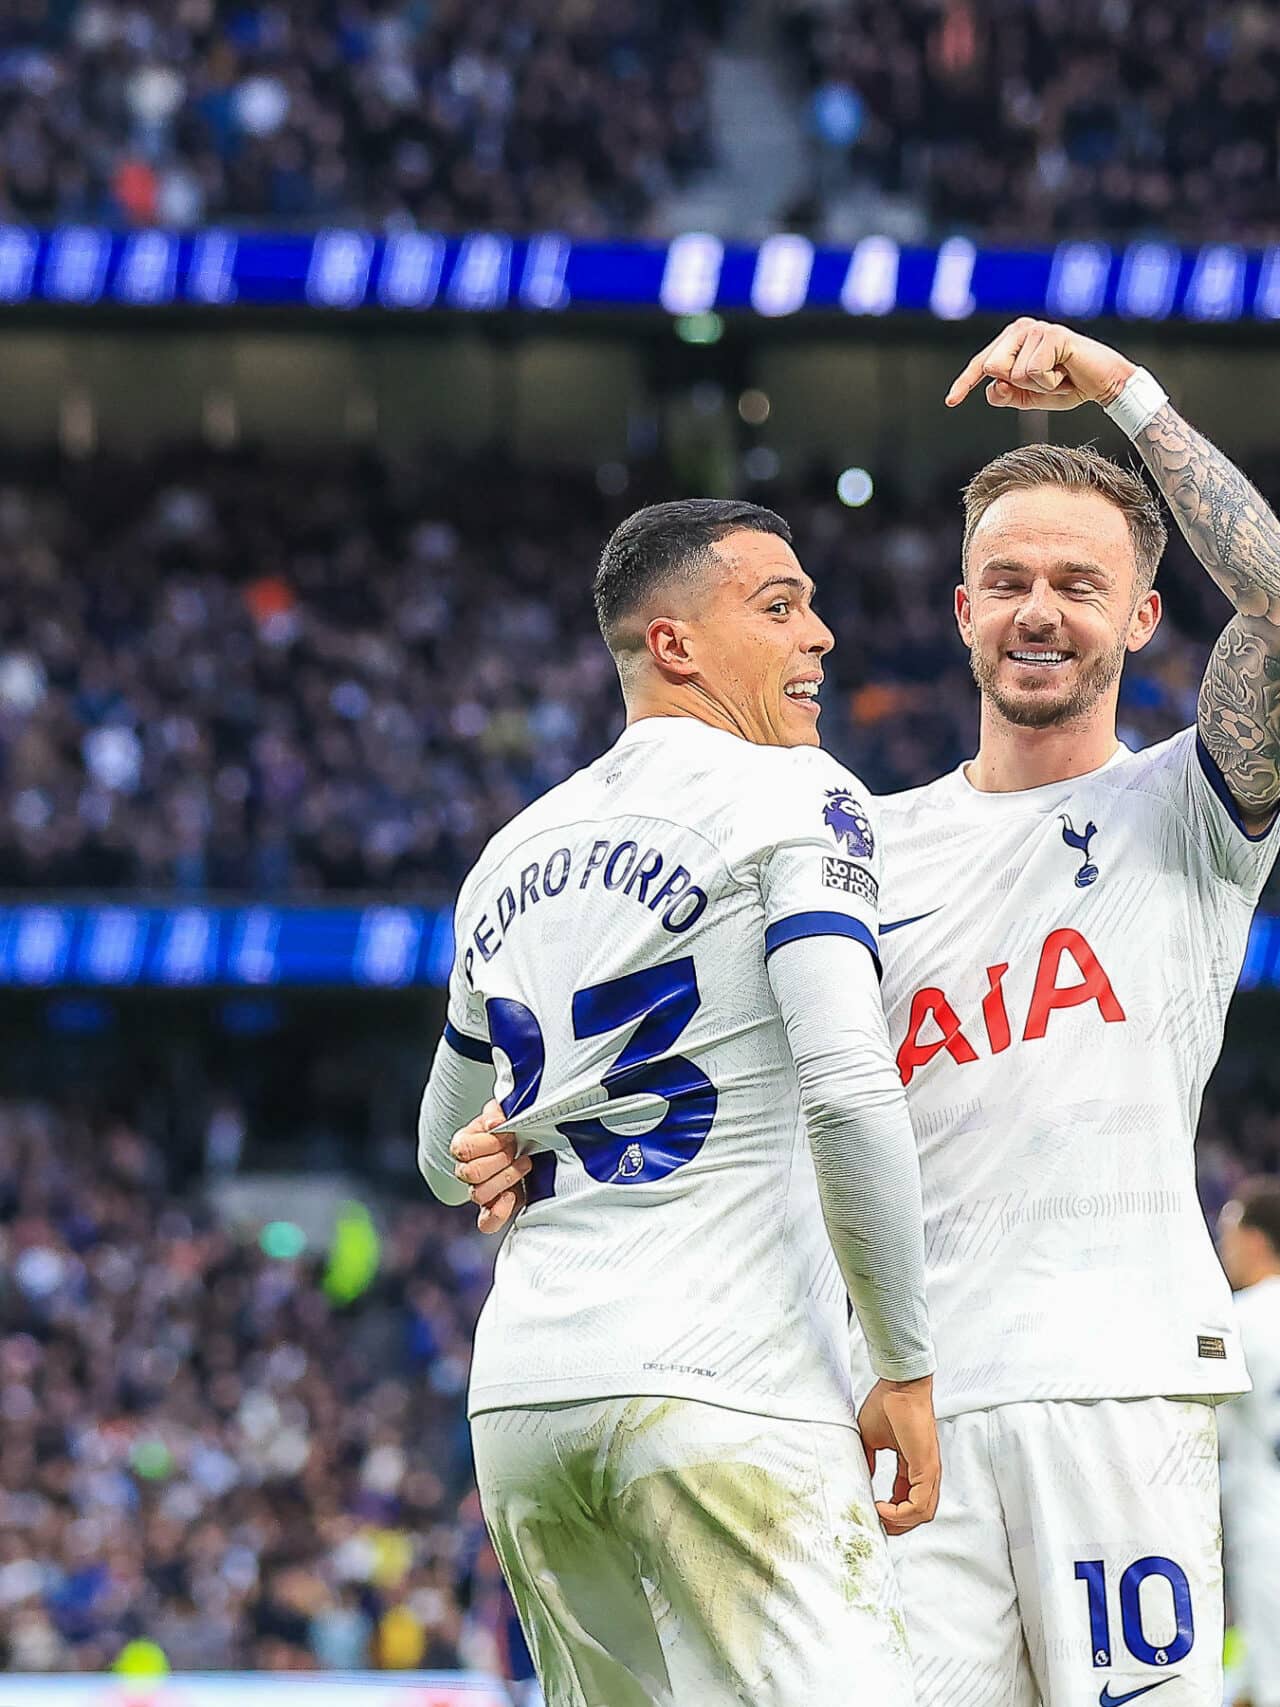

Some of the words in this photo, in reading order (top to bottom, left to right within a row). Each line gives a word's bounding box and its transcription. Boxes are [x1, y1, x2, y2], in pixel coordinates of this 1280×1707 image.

[465, 848, 572, 990] PEDRO
[822, 857, 849, 877] No
[896, 928, 1126, 1087] AIA
[1074, 1555, 1195, 1667] 10
